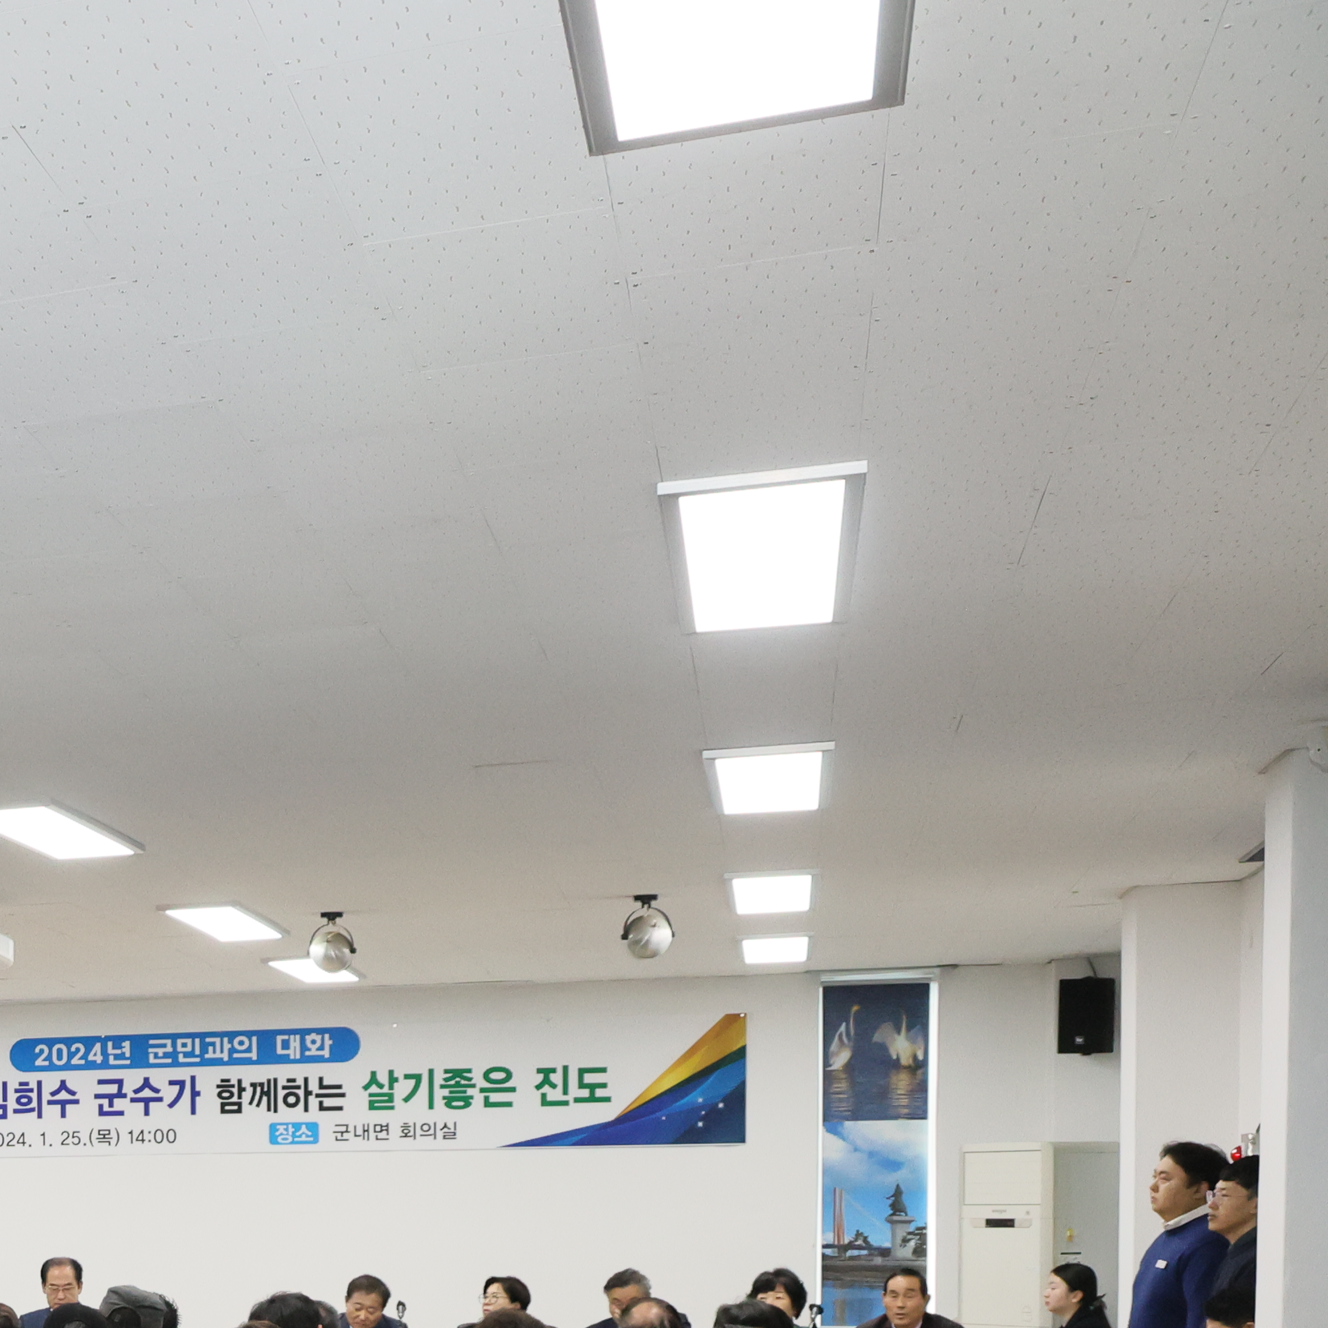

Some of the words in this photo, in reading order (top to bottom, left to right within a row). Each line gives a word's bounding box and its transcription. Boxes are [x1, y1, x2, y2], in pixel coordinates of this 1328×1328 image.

[34, 1039, 132, 1067] 2024년
[147, 1035, 258, 1064] 군민과의
[276, 1033, 333, 1060] 대화
[93, 1075, 201, 1117] 군수가
[215, 1076, 347, 1114] 함께하는
[361, 1066, 518, 1111] 살기좋은
[534, 1064, 613, 1107] 진도
[39, 1131, 54, 1148] 1.
[60, 1128, 121, 1147] 25.(목)
[127, 1128, 178, 1146] 14:00
[274, 1124, 314, 1143] 장소
[332, 1122, 391, 1142] 군내면
[399, 1120, 459, 1140] 회의실
